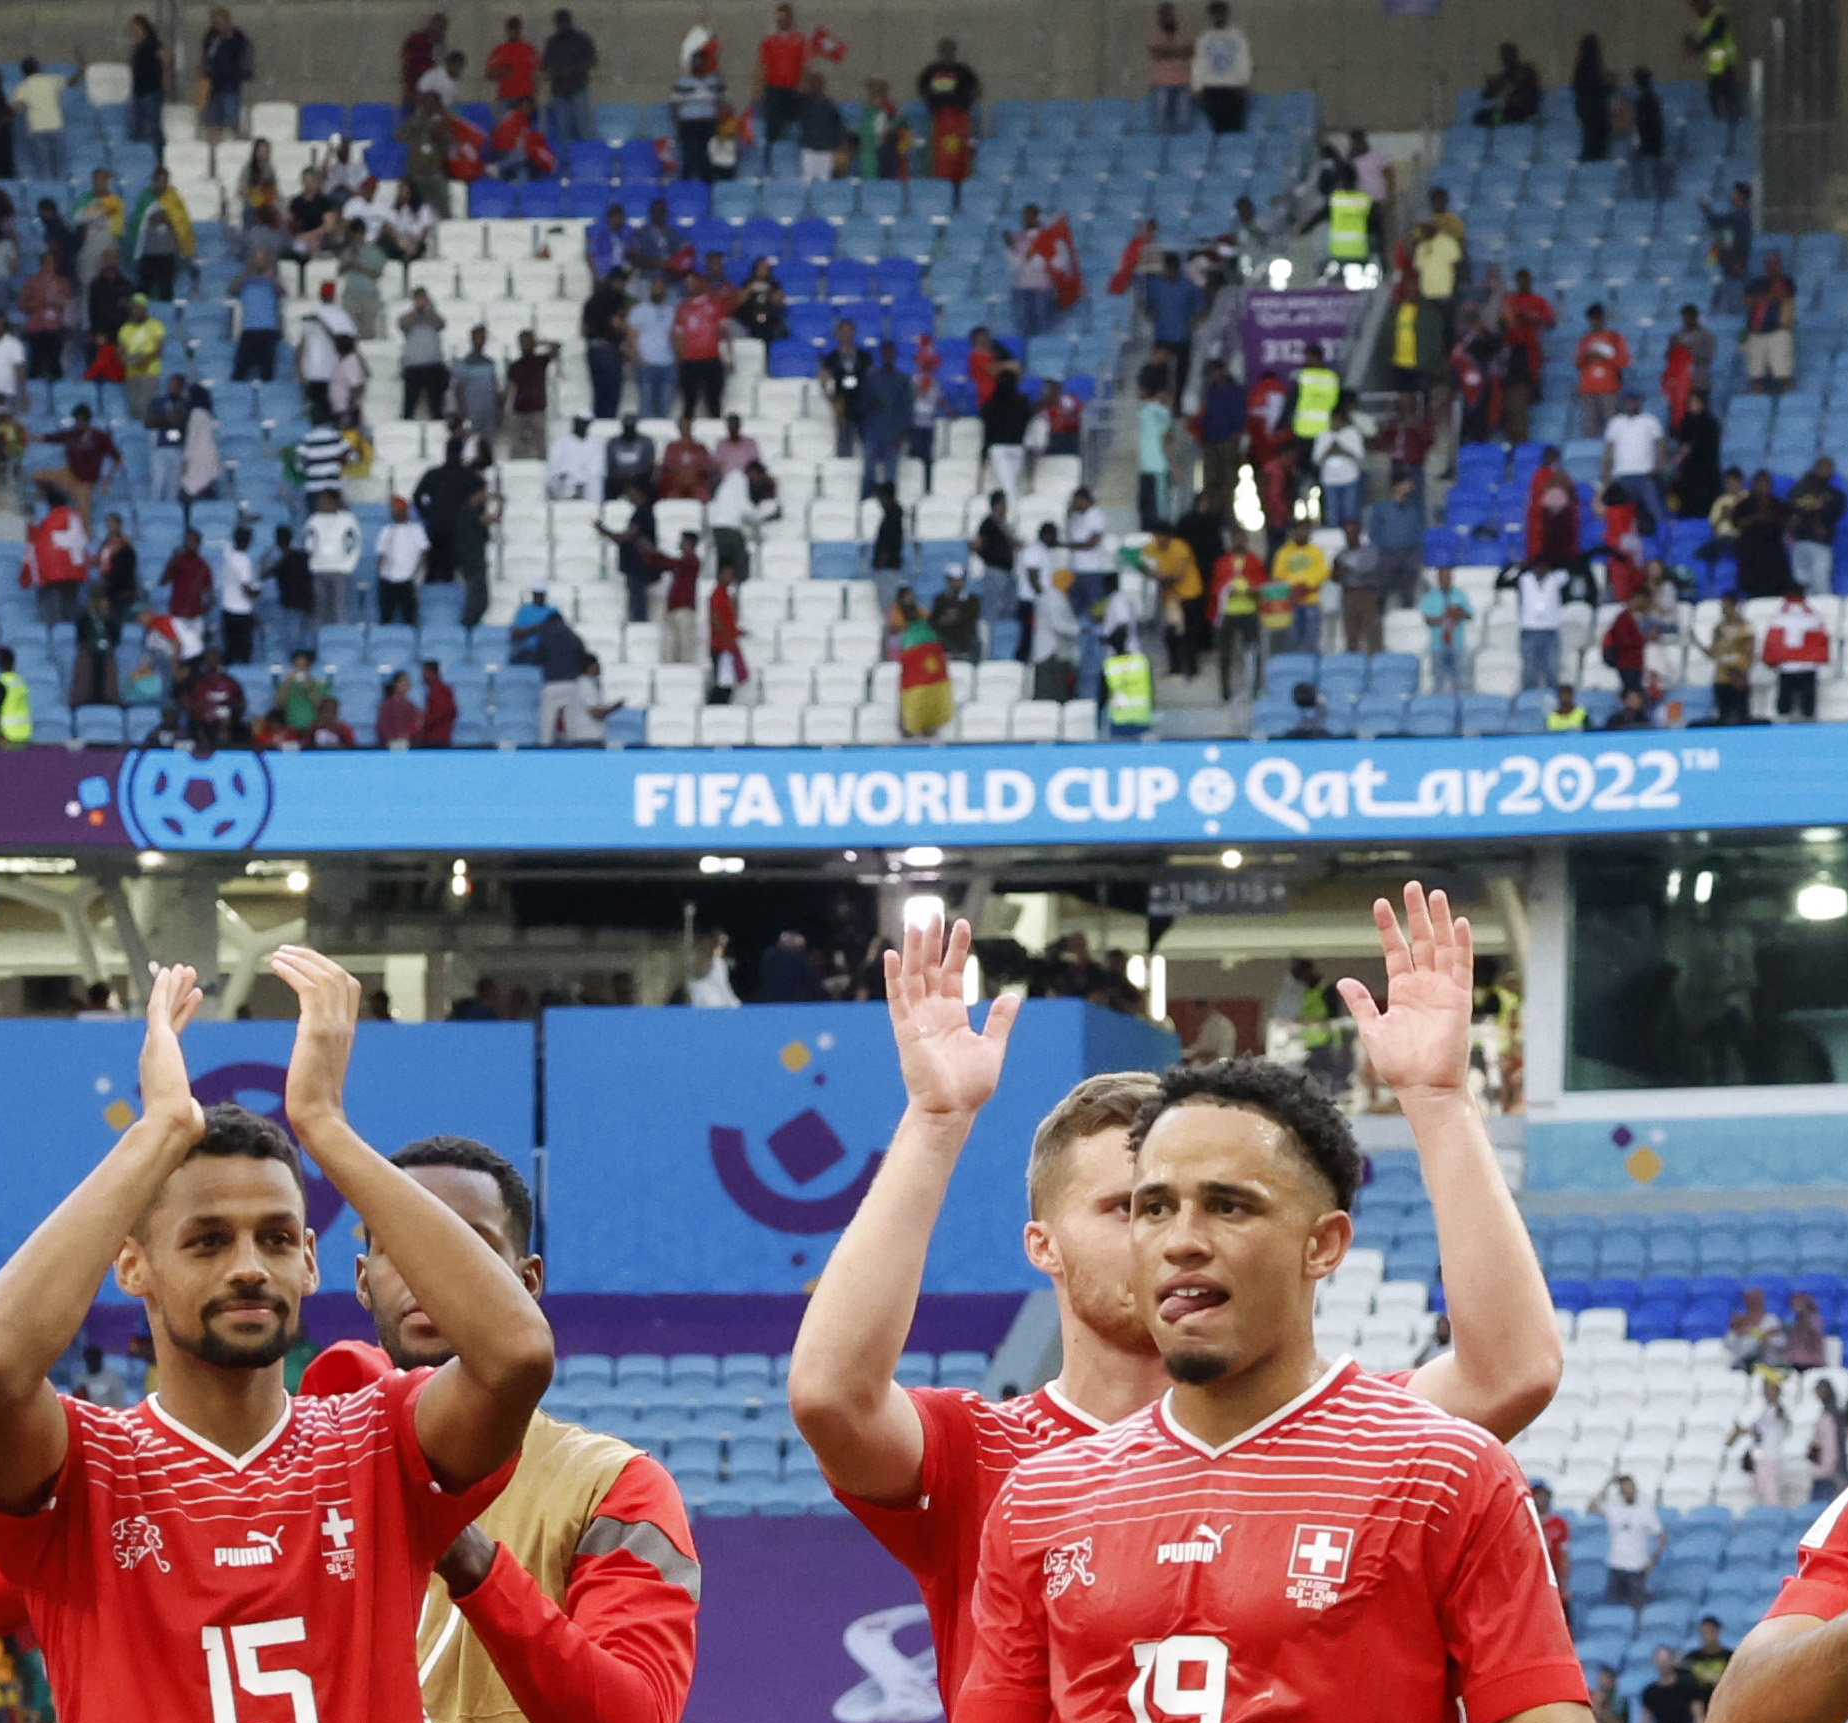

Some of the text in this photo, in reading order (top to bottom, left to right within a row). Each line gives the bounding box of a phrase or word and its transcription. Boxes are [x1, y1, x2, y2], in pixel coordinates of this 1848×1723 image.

[634, 764, 1179, 828] FIFA WORLD CUP
[214, 1544, 274, 1568] PUMA
[1156, 1541, 1215, 1565] PUMA
[1285, 1585, 1304, 1599] SUI
[1311, 1589, 1339, 1604] CMR
